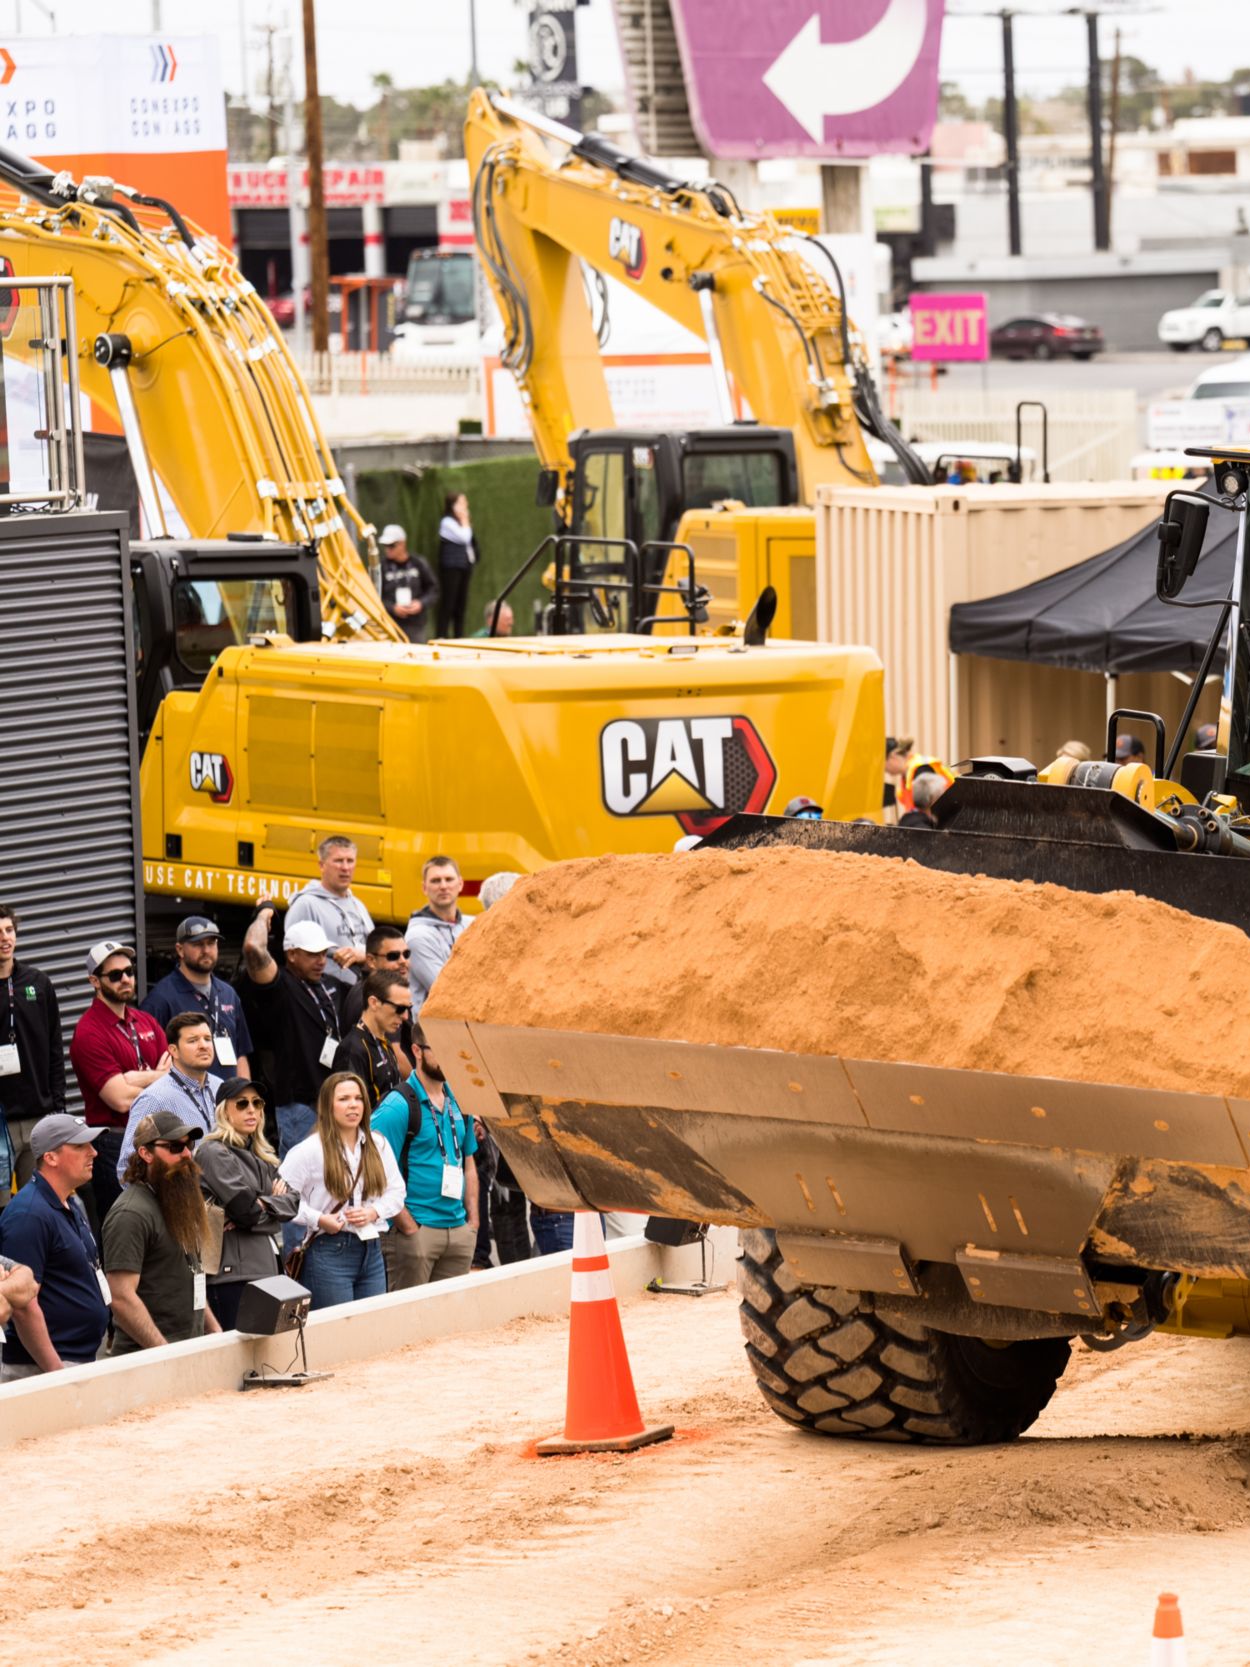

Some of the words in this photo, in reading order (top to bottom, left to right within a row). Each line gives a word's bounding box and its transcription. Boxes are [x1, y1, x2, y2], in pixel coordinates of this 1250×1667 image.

[609, 216, 641, 269] CAT
[914, 309, 984, 346] EXIT
[190, 751, 223, 793] CAT
[602, 717, 733, 815] CAT
[145, 865, 174, 887] USE
